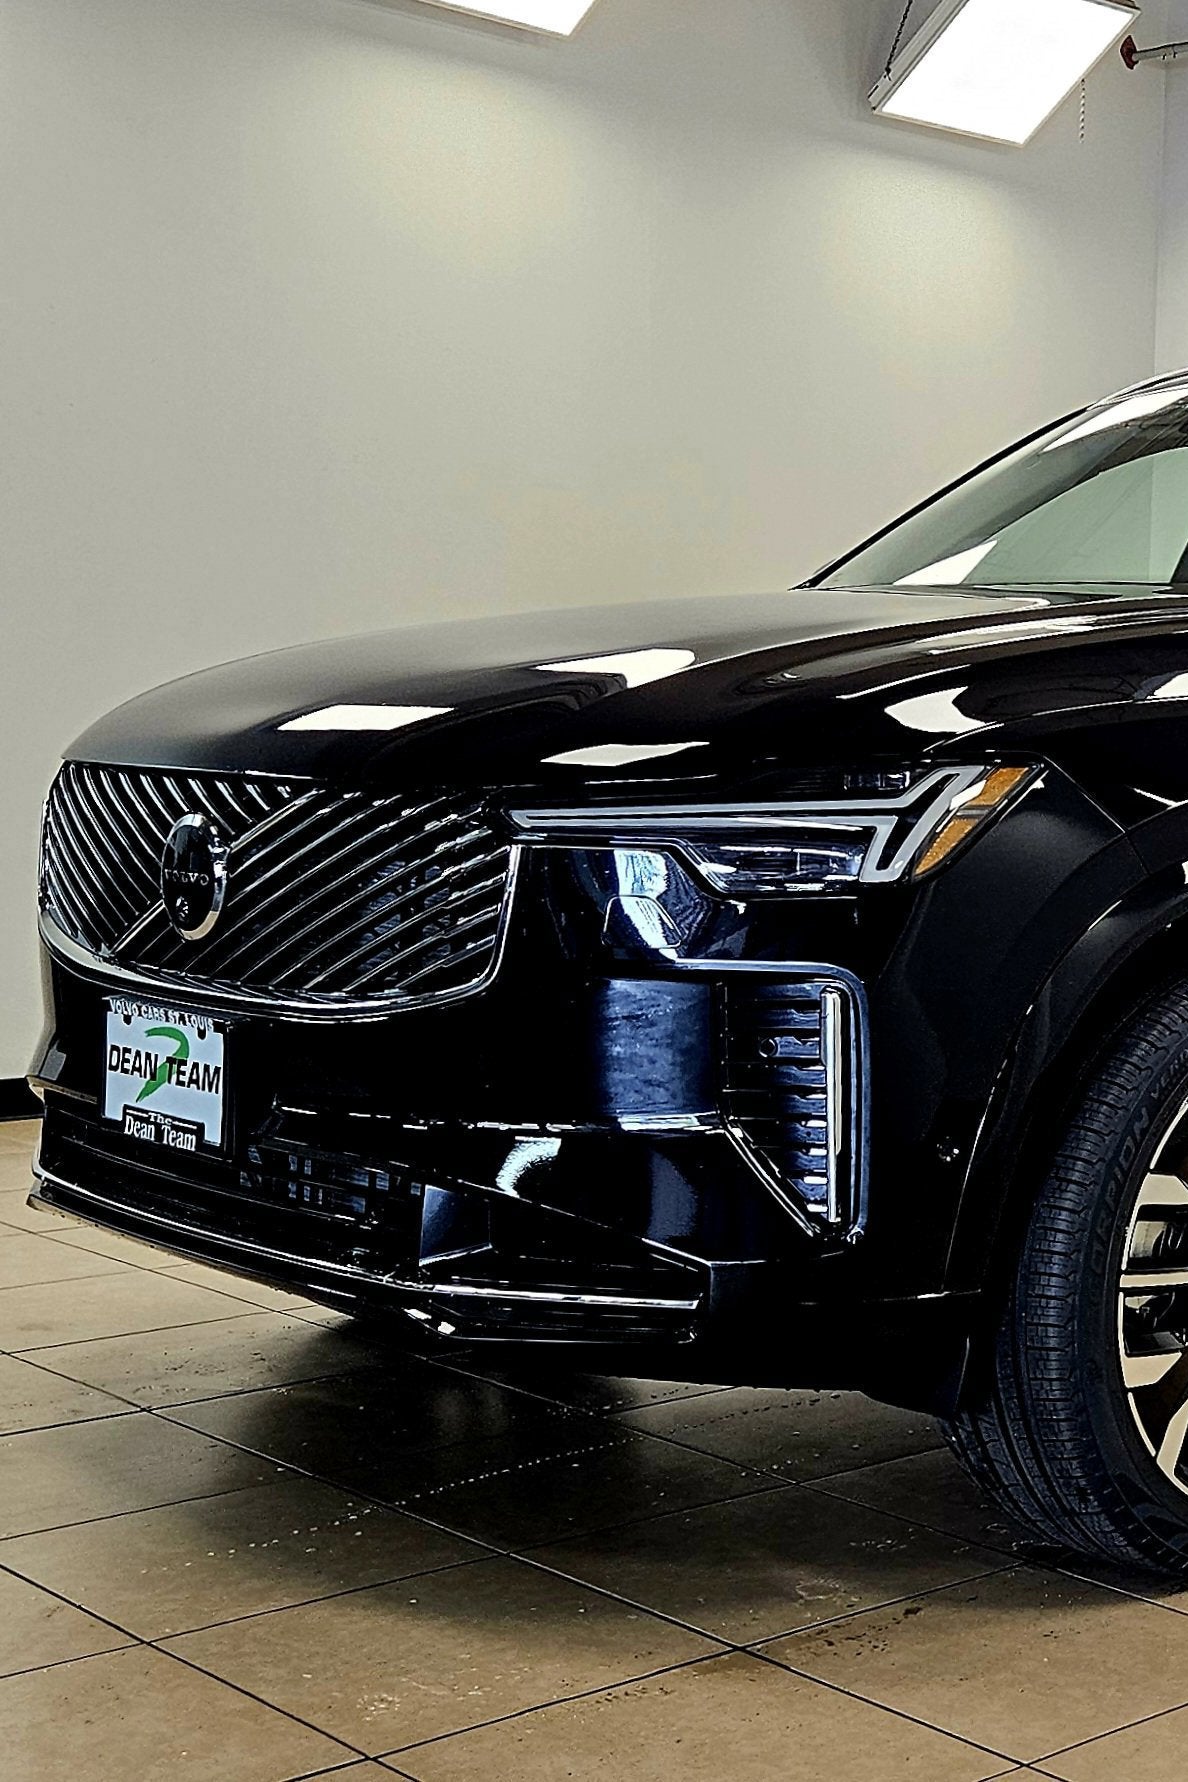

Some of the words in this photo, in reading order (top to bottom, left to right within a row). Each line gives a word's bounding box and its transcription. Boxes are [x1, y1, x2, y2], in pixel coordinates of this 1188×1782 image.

[109, 998, 140, 1017] VOLVO
[141, 1003, 166, 1022] CARS
[108, 1044, 158, 1081] DEAN
[166, 1055, 221, 1094] TEAM
[124, 1115, 155, 1141] Dean
[161, 1125, 196, 1152] Team
[148, 1112, 173, 1126] The
